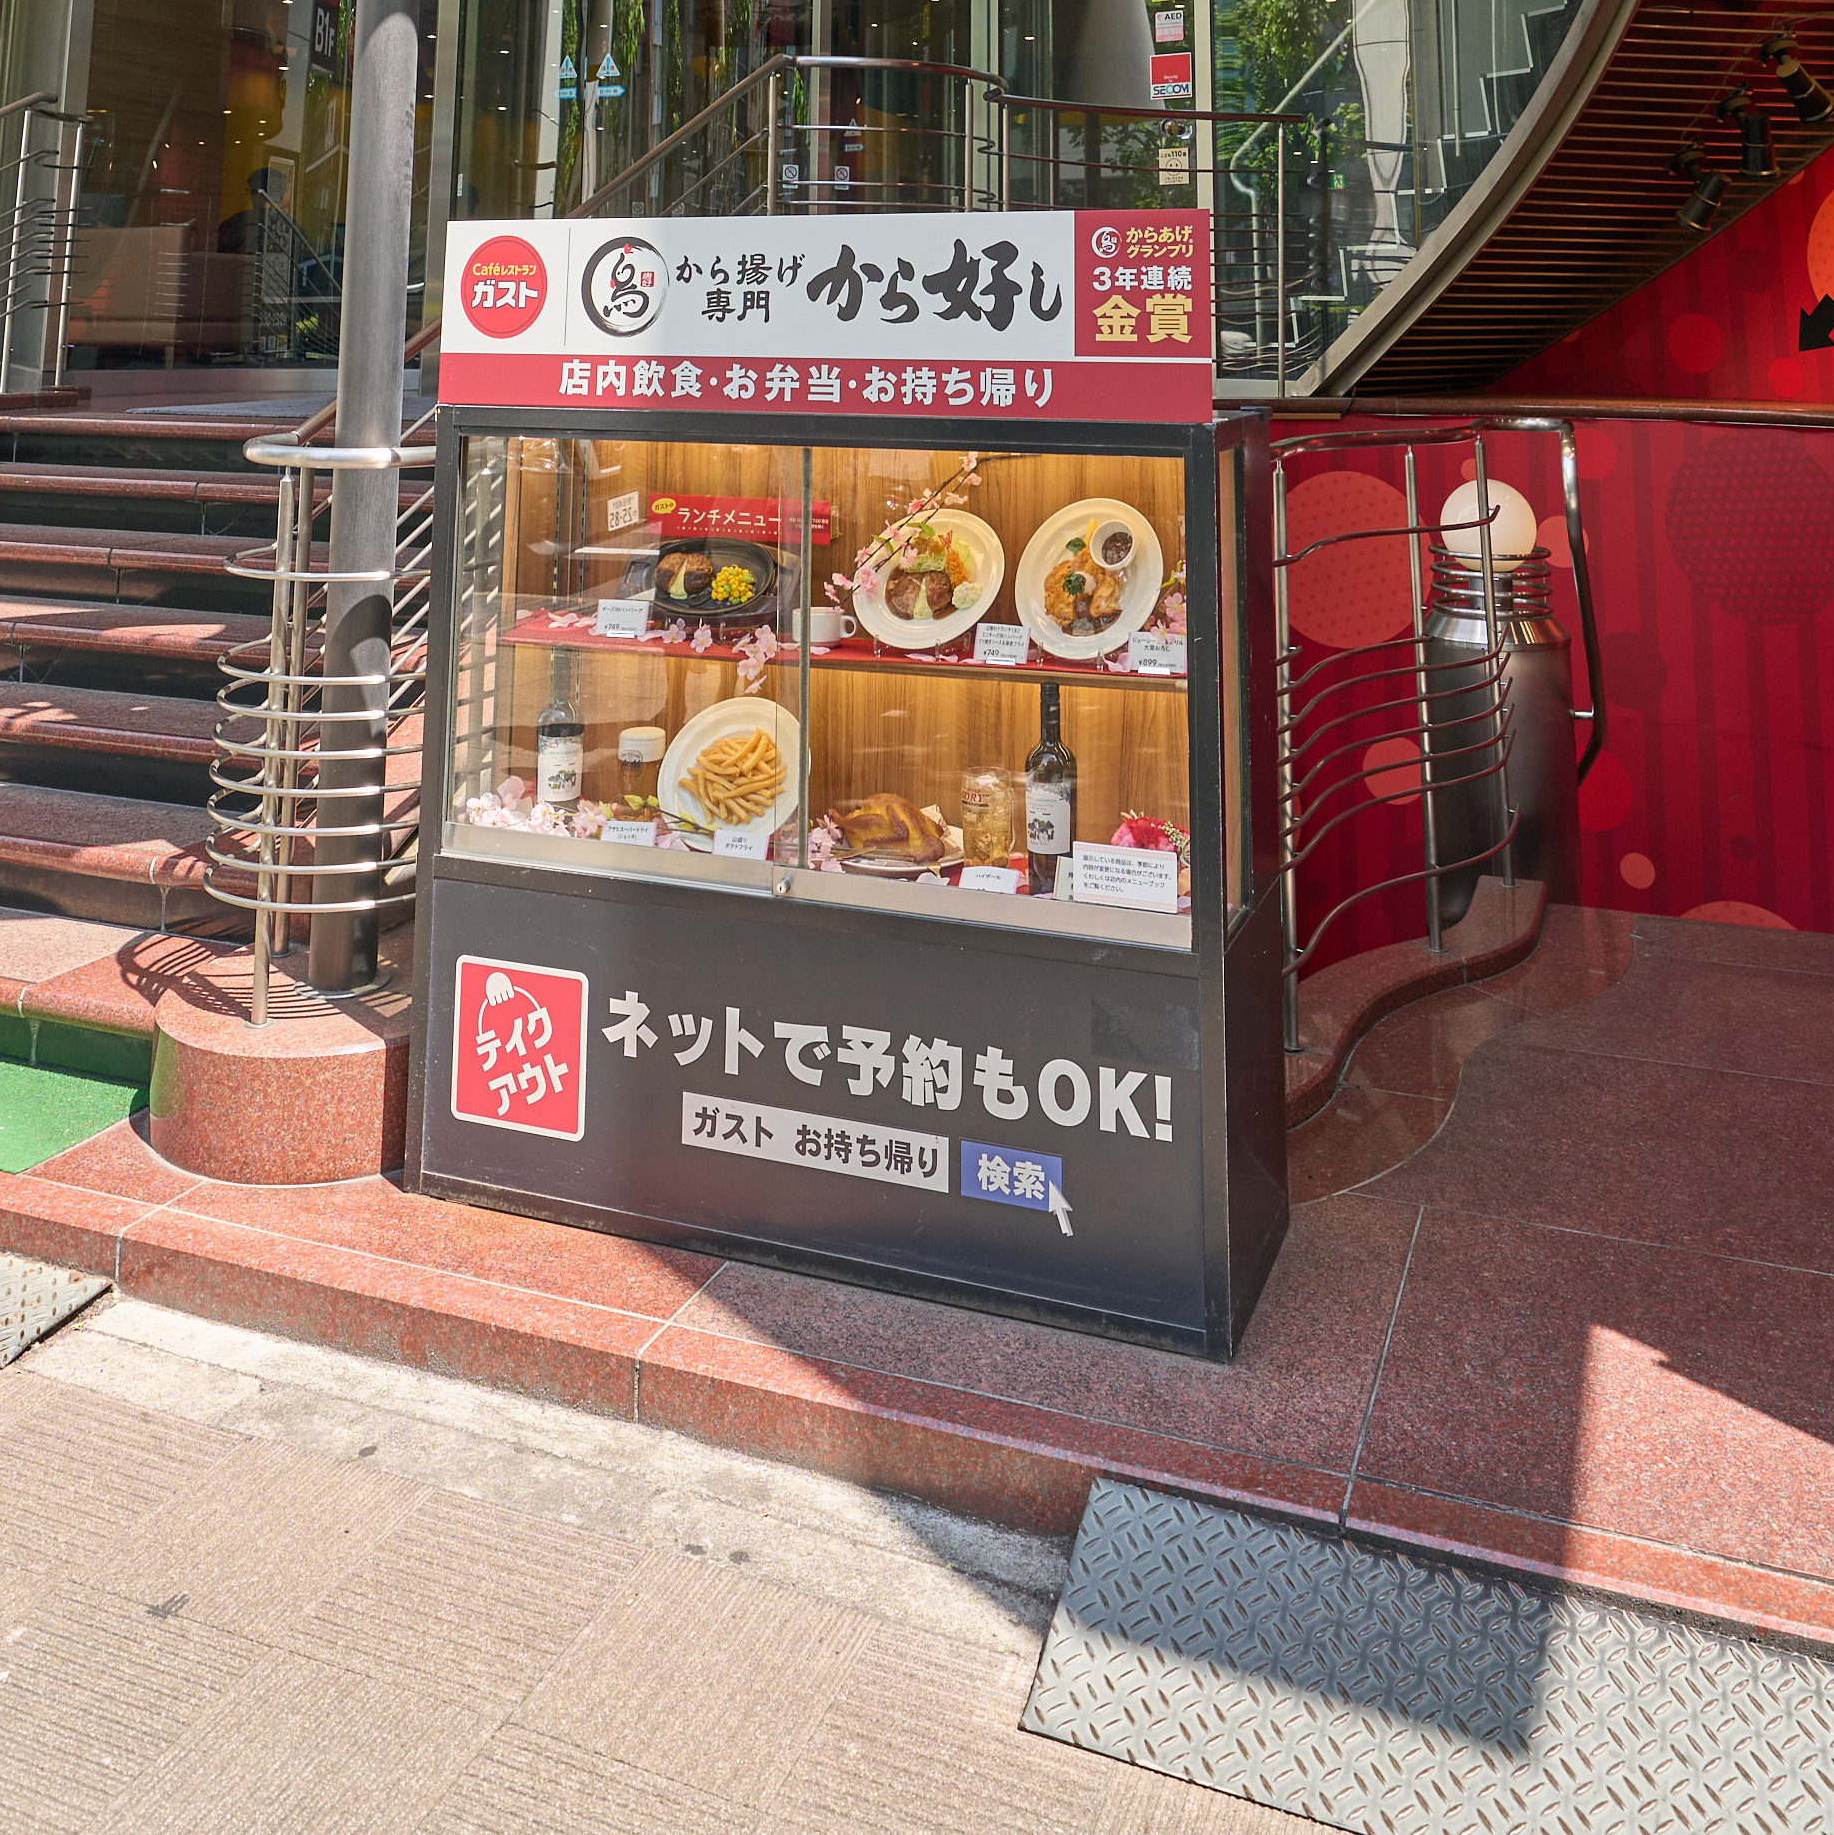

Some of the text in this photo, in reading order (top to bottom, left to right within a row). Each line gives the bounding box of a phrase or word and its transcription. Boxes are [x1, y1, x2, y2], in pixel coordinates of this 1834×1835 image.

[1164, 12, 1182, 21] AED
[1153, 84, 1189, 96] SECOM
[1126, 225, 1192, 244] からあげ
[1126, 243, 1194, 259] グランプリ
[675, 252, 806, 289] から揚げ
[1092, 265, 1193, 292] 3年連続
[471, 278, 539, 309] ガスト
[806, 238, 1063, 332] から好し
[701, 289, 770, 324] 専門
[1091, 293, 1193, 344] 金賞
[677, 507, 782, 526] ランチメニュー
[983, 648, 1000, 656] ¥749
[1138, 658, 1158, 667] ¥899
[974, 872, 1002, 880] ハイボール
[476, 1004, 552, 1073] テイク
[487, 1052, 570, 1117] アウト
[691, 1104, 1046, 1202] ガスト お持ち帰り 検索
